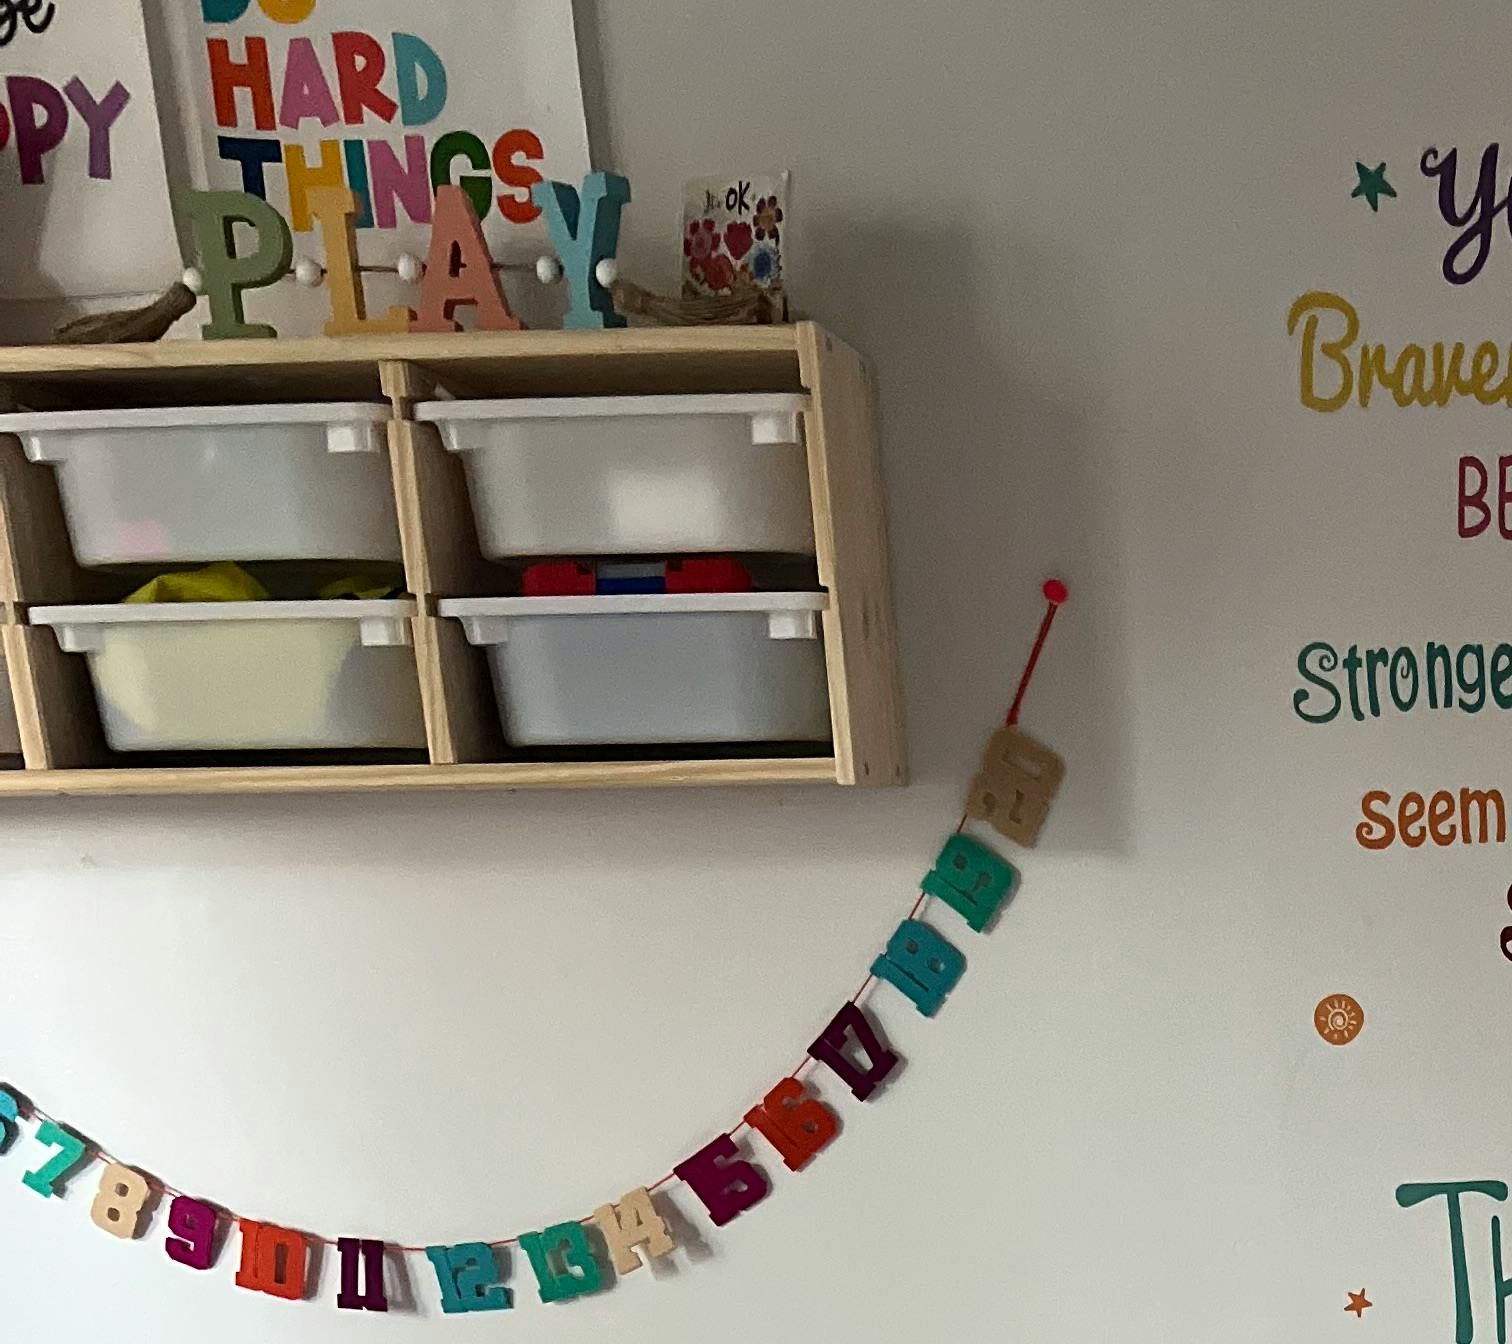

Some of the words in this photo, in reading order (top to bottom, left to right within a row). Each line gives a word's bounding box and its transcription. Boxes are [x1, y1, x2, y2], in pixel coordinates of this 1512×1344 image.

[206, 31, 448, 131] HARD
[217, 128, 545, 232] THINGS
[725, 180, 751, 216] OK
[186, 170, 632, 340] PLAY
[963, 727, 1066, 849] 20
[921, 832, 1015, 934] 19
[870, 919, 967, 1018] 18
[807, 1001, 899, 1102] 17
[22, 1119, 86, 1198] 7
[744, 1077, 839, 1172] 16
[91, 1163, 150, 1239] 8
[673, 1133, 768, 1227] 15
[165, 1195, 218, 1271] 9
[235, 1217, 308, 1301] 10
[337, 1237, 388, 1312] 11
[518, 1221, 602, 1304] 13
[593, 1187, 675, 1275] 14
[425, 1241, 514, 1313] 12
